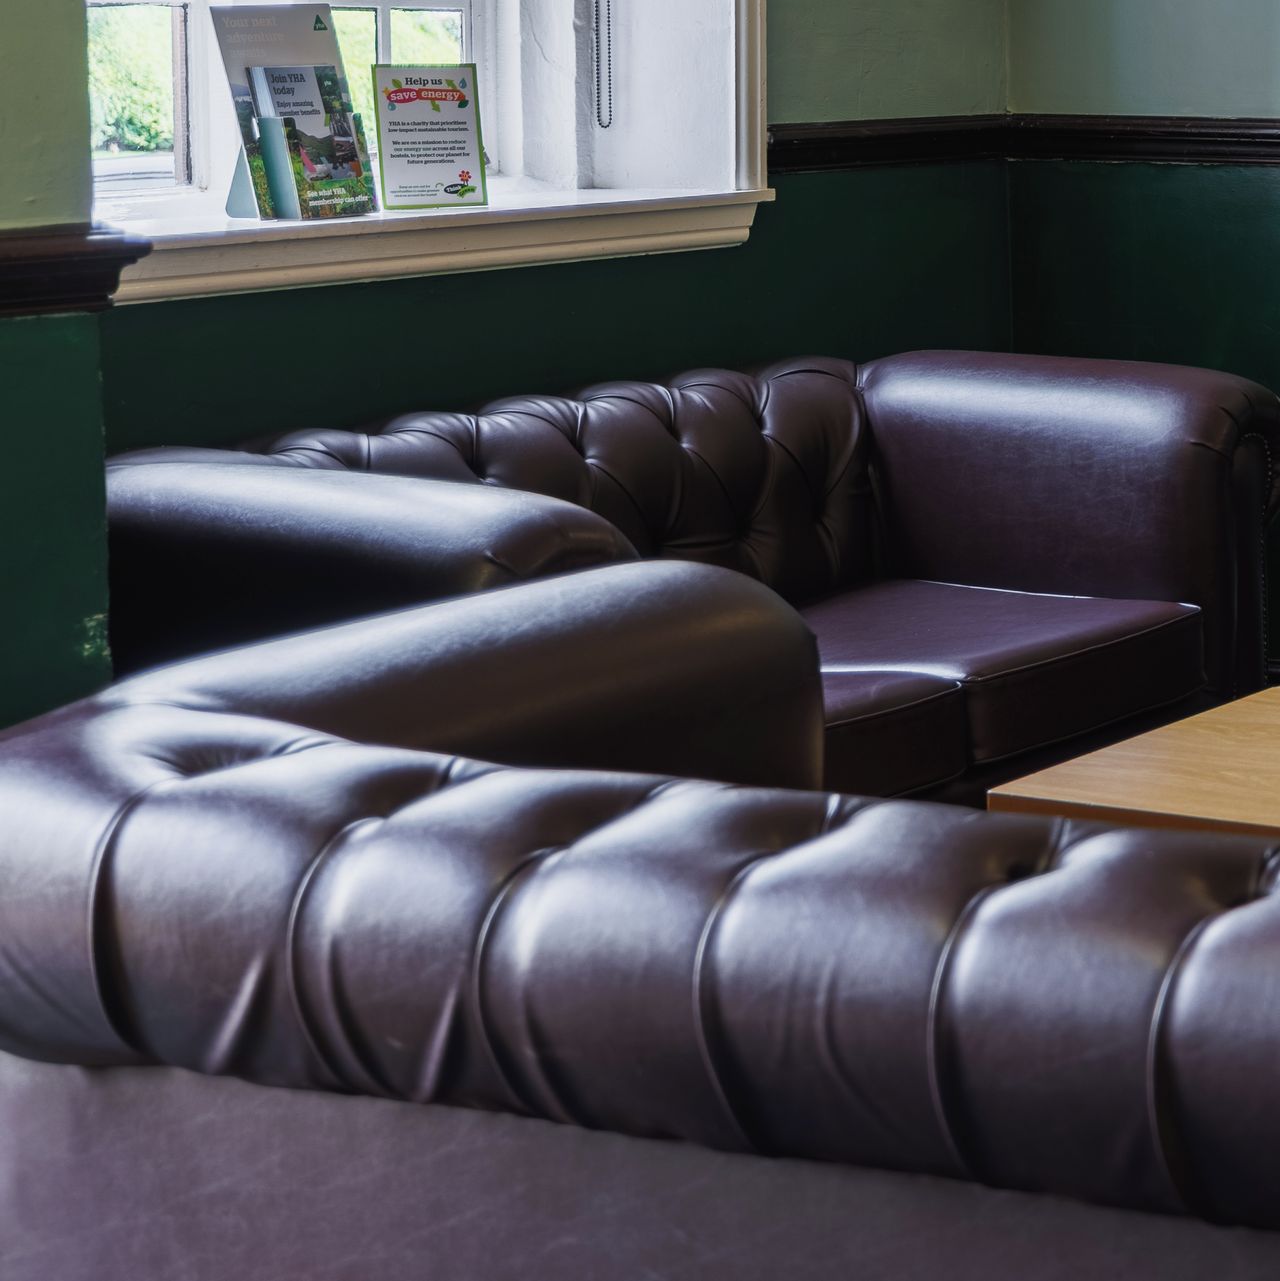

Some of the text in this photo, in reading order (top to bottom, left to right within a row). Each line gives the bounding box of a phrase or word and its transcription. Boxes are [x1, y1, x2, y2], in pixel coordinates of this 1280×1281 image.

[271, 73, 306, 84] Join YHA
[405, 77, 443, 87] Help us
[273, 86, 295, 96] today
[390, 91, 460, 101] save energy
[276, 101, 292, 109] Enjoy
[318, 189, 333, 197] what
[333, 187, 346, 195] YHA
[309, 198, 345, 207] membership
